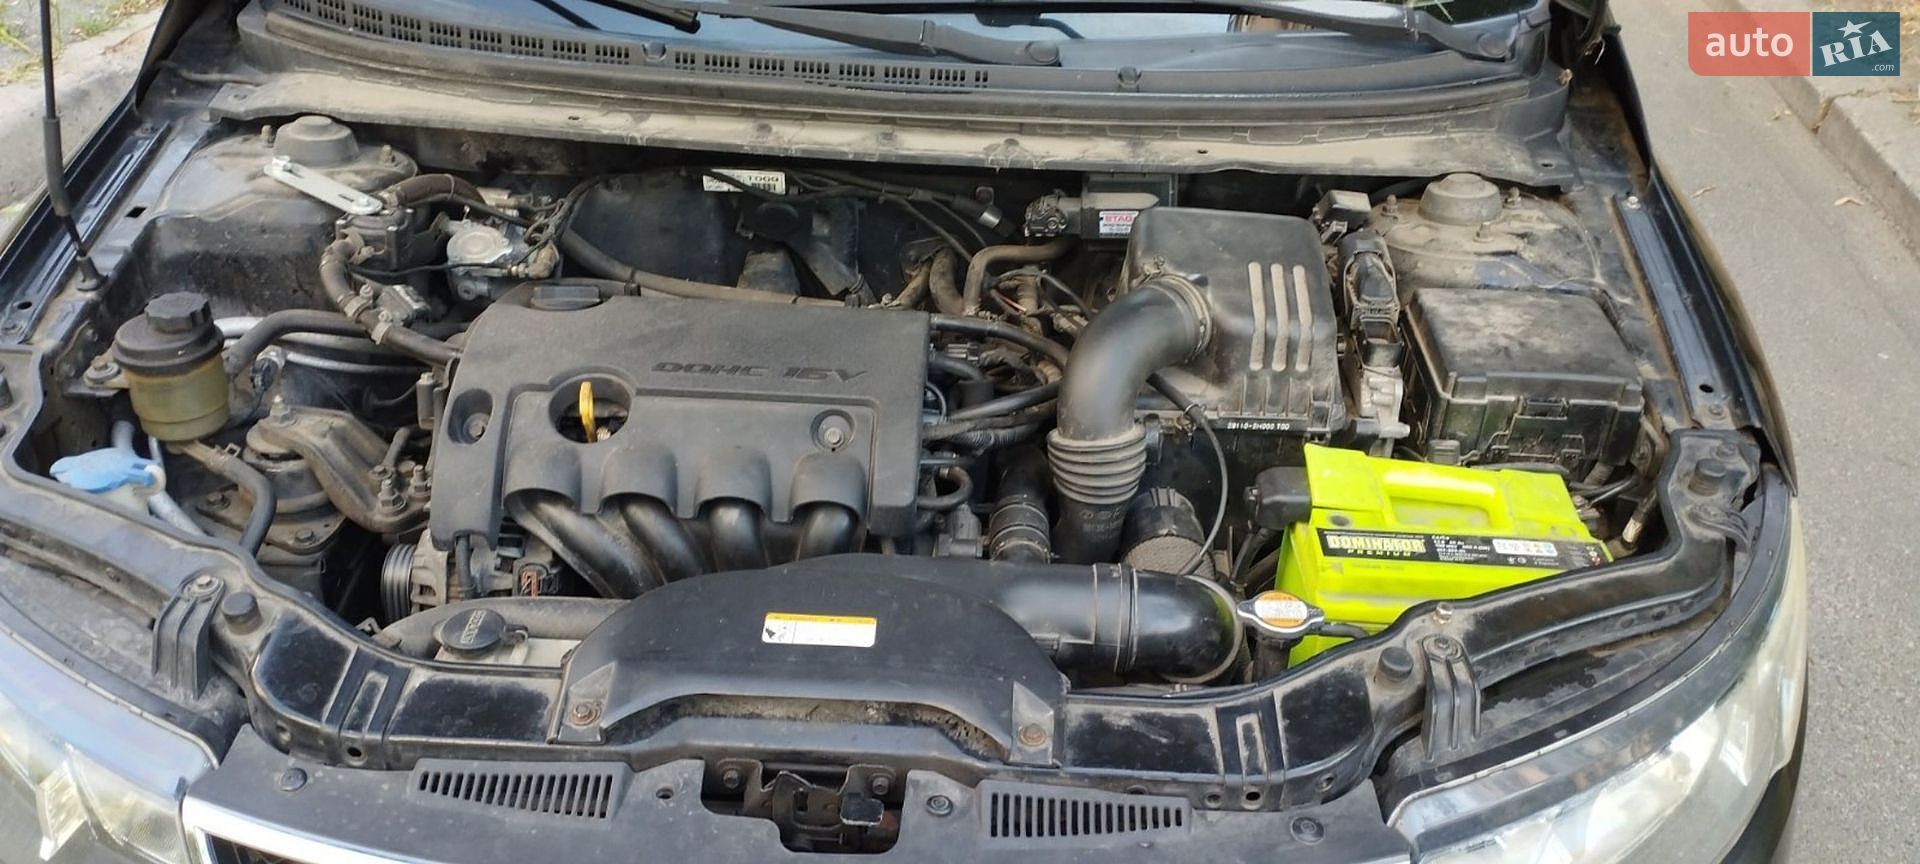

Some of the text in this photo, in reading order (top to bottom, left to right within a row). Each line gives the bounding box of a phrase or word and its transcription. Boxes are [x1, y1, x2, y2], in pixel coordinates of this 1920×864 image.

[651, 362, 868, 382] DOHC 16V
[1326, 535, 1426, 553] DOMINATOR
[1347, 549, 1411, 557] PREMIUM
